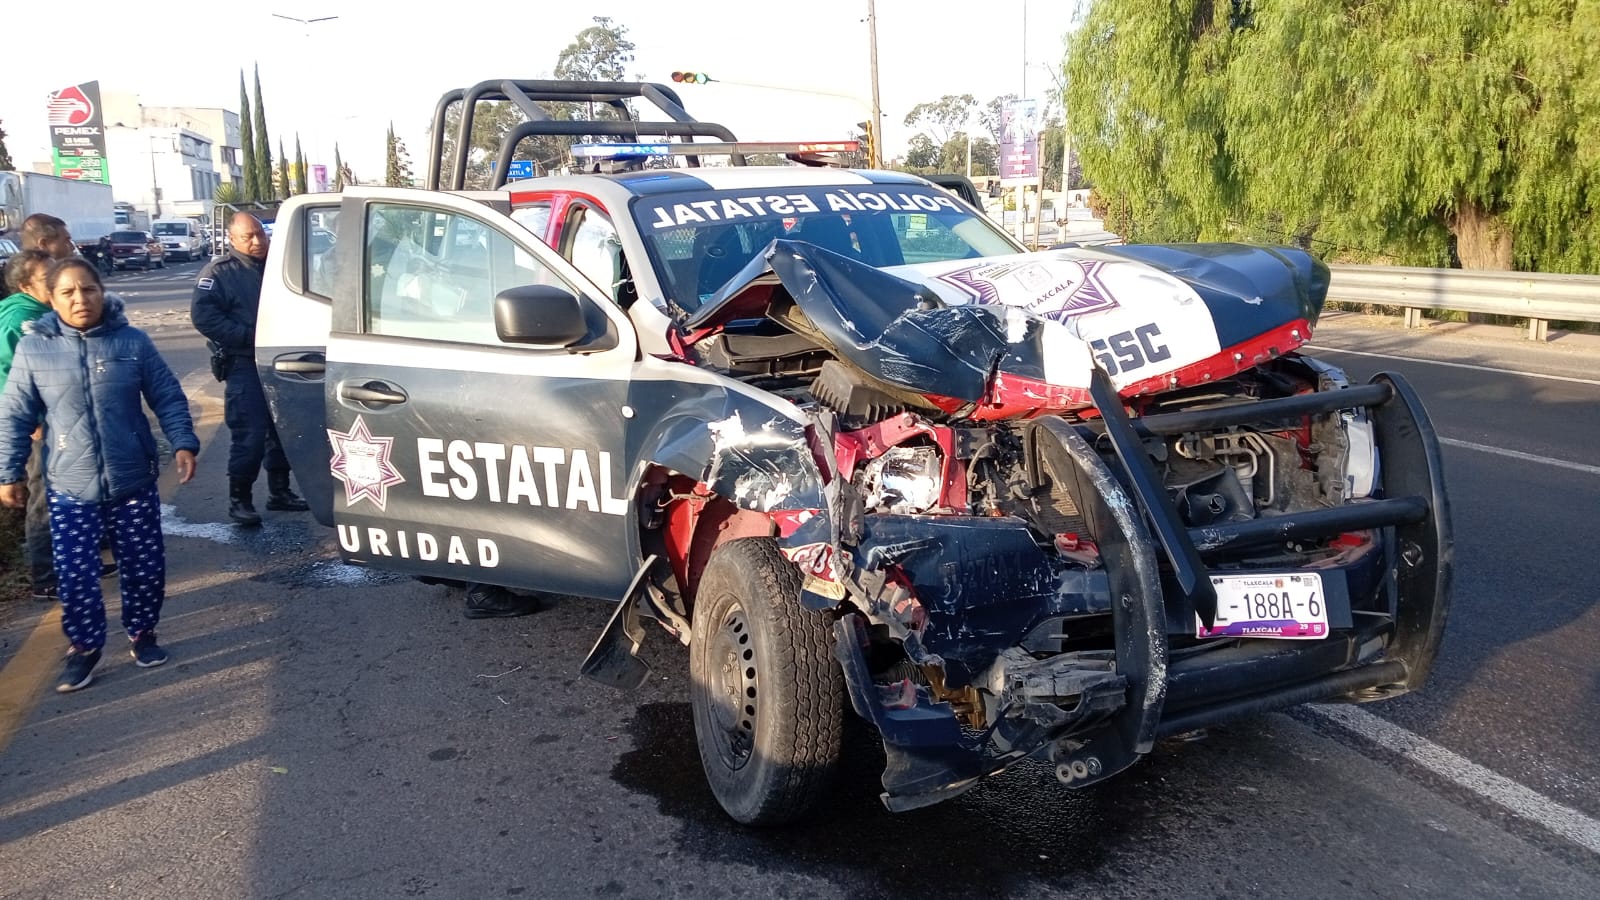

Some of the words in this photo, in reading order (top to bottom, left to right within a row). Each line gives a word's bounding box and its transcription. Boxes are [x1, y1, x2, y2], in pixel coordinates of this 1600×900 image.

[54, 127, 101, 135] PEMEX
[1026, 279, 1075, 311] TLAXCALA
[417, 437, 630, 516] ESTATAL
[337, 524, 500, 568] URIDAD
